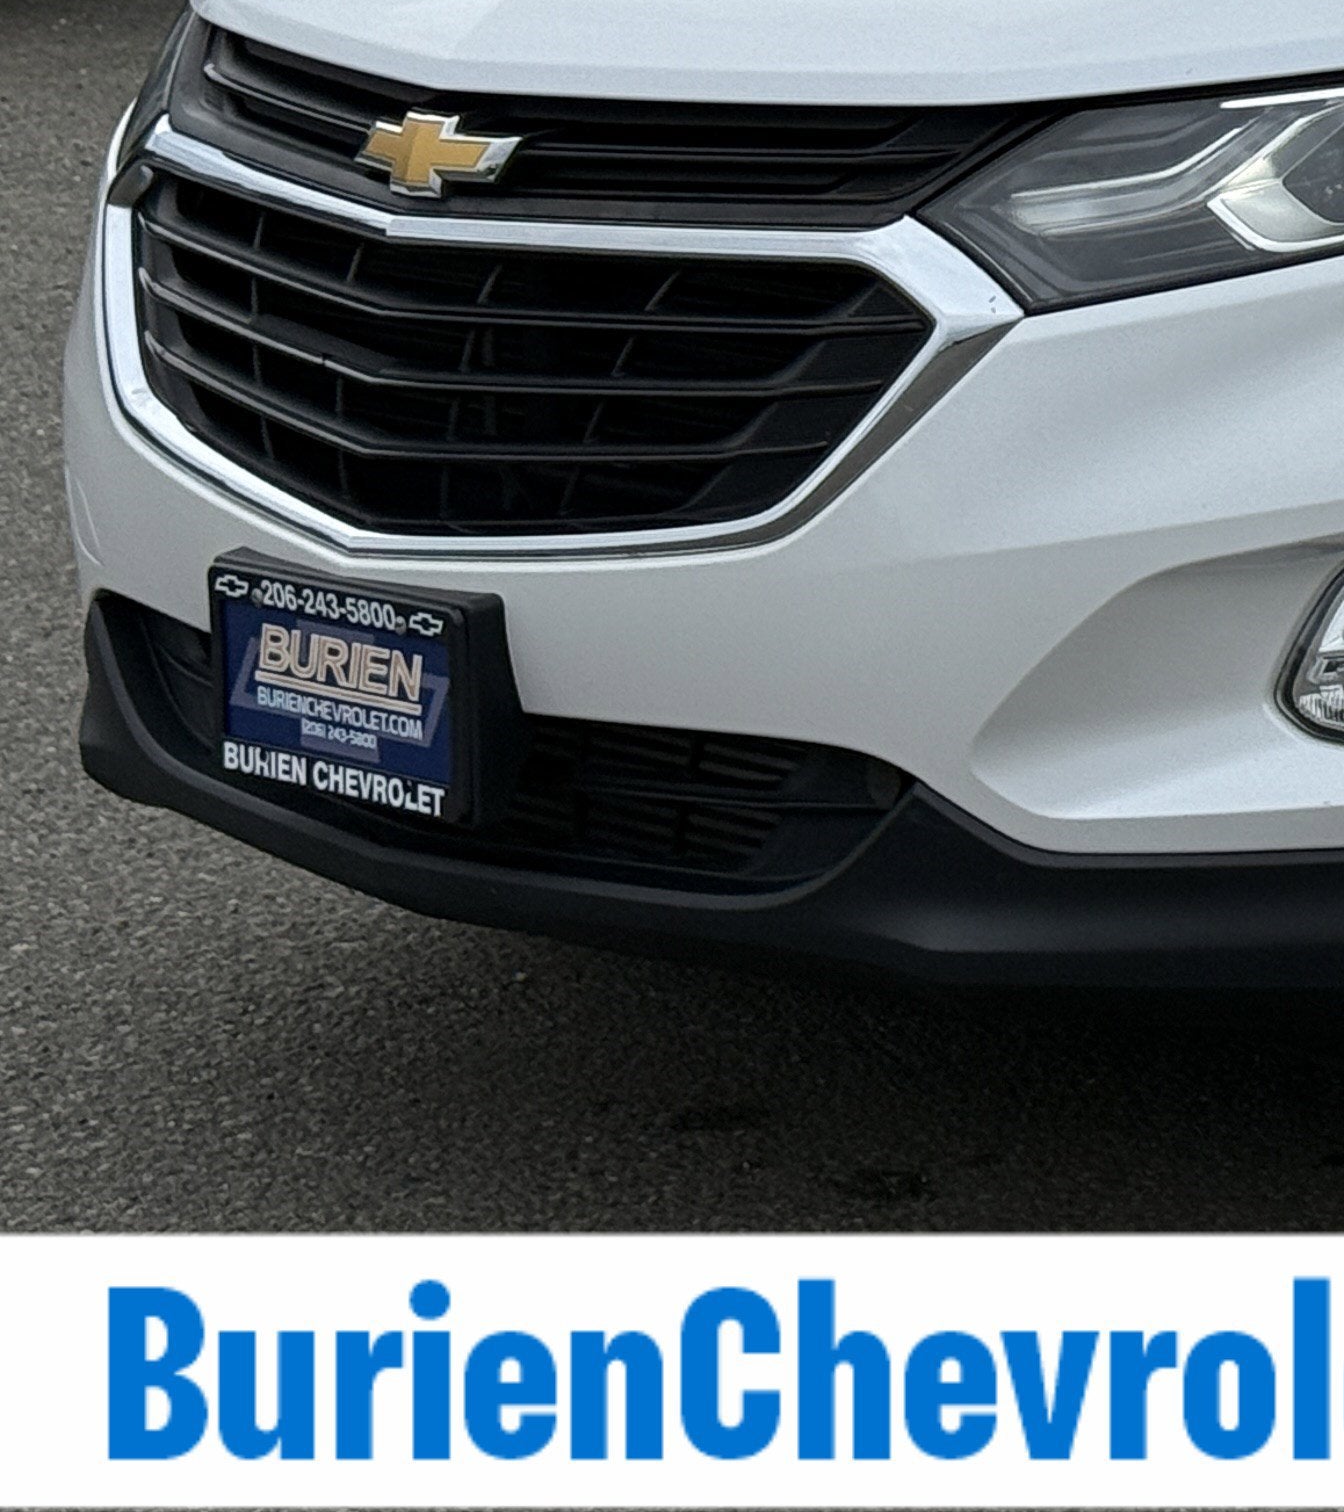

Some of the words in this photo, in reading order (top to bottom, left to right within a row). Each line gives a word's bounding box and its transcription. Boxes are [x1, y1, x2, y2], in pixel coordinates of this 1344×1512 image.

[260, 579, 396, 631] 206-243-5800
[258, 622, 424, 702] BURIEN
[256, 685, 423, 741] BURIENCHEVROLET.COM
[223, 740, 308, 787] BURIEN
[312, 759, 445, 817] CHEVROLET
